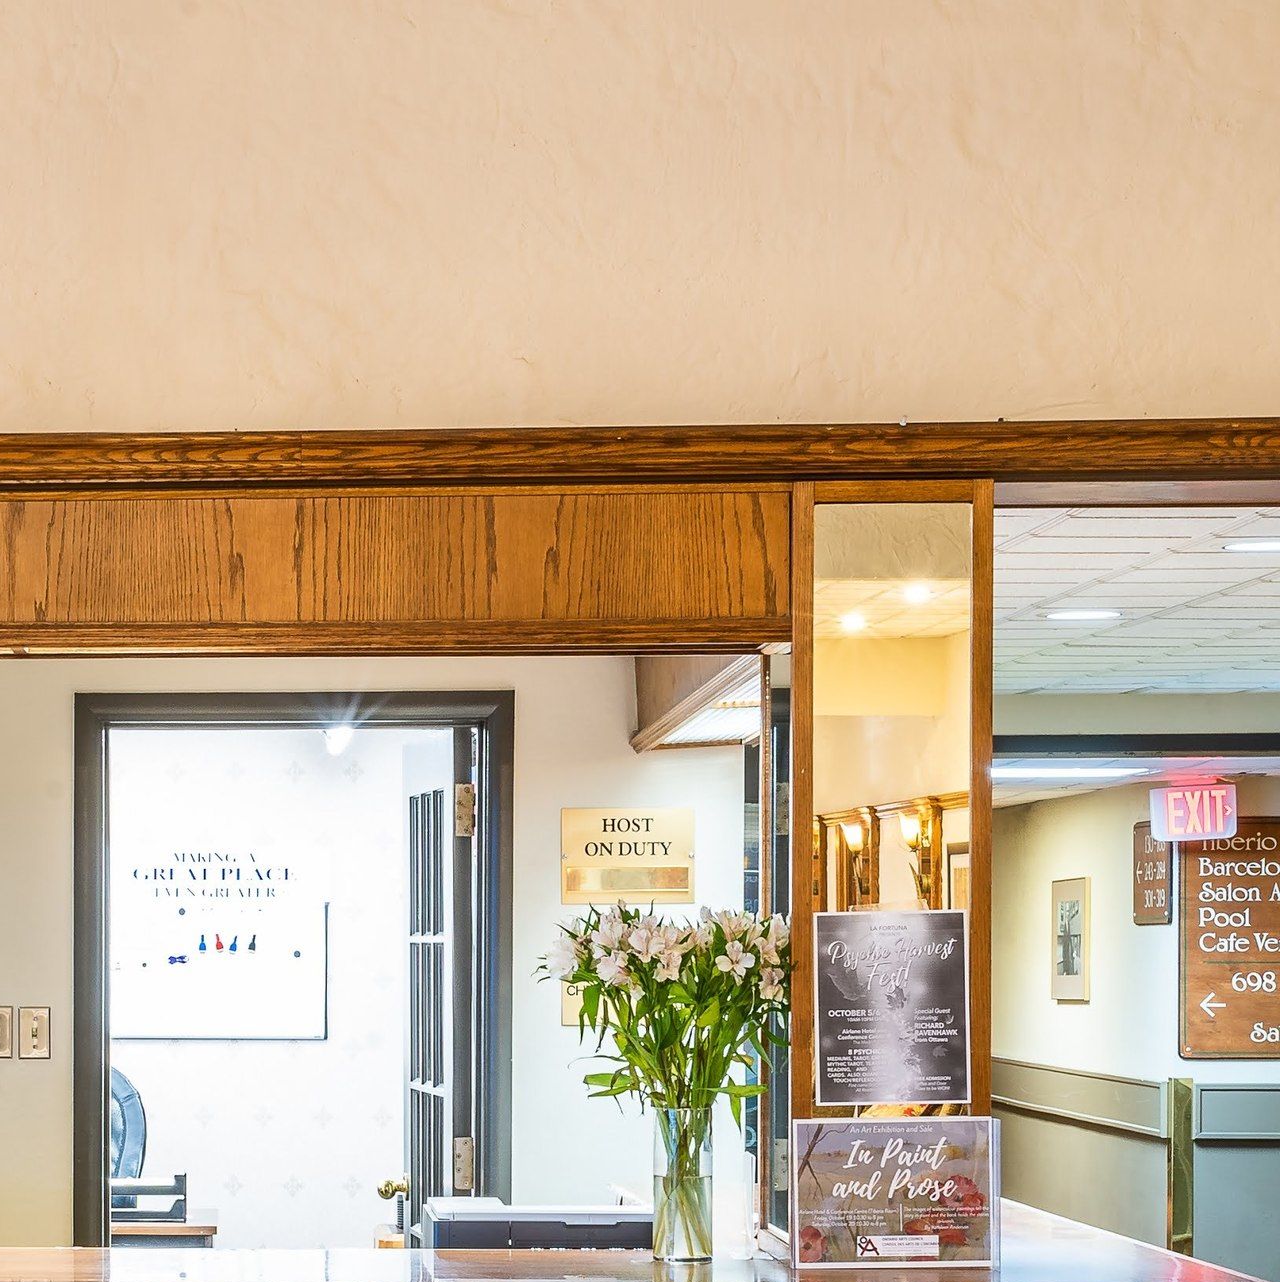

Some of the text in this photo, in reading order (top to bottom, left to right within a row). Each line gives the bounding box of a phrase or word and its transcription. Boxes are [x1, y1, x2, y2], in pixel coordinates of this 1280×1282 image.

[1167, 789, 1227, 835] EXIT
[602, 818, 654, 832] HOST
[585, 842, 672, 856] ON DUTY
[1198, 882, 1262, 902] Salon
[1198, 907, 1251, 927] Pool
[1199, 932, 1250, 952] Cafe
[827, 937, 958, 971] Psychic Harvest
[866, 960, 913, 994] Fest!
[1231, 971, 1277, 993] 698
[873, 1125, 904, 1133] Exhibition
[919, 1124, 933, 1132] Sale
[843, 1136, 947, 1170] In Paint
[832, 1168, 958, 1201] and Prose
